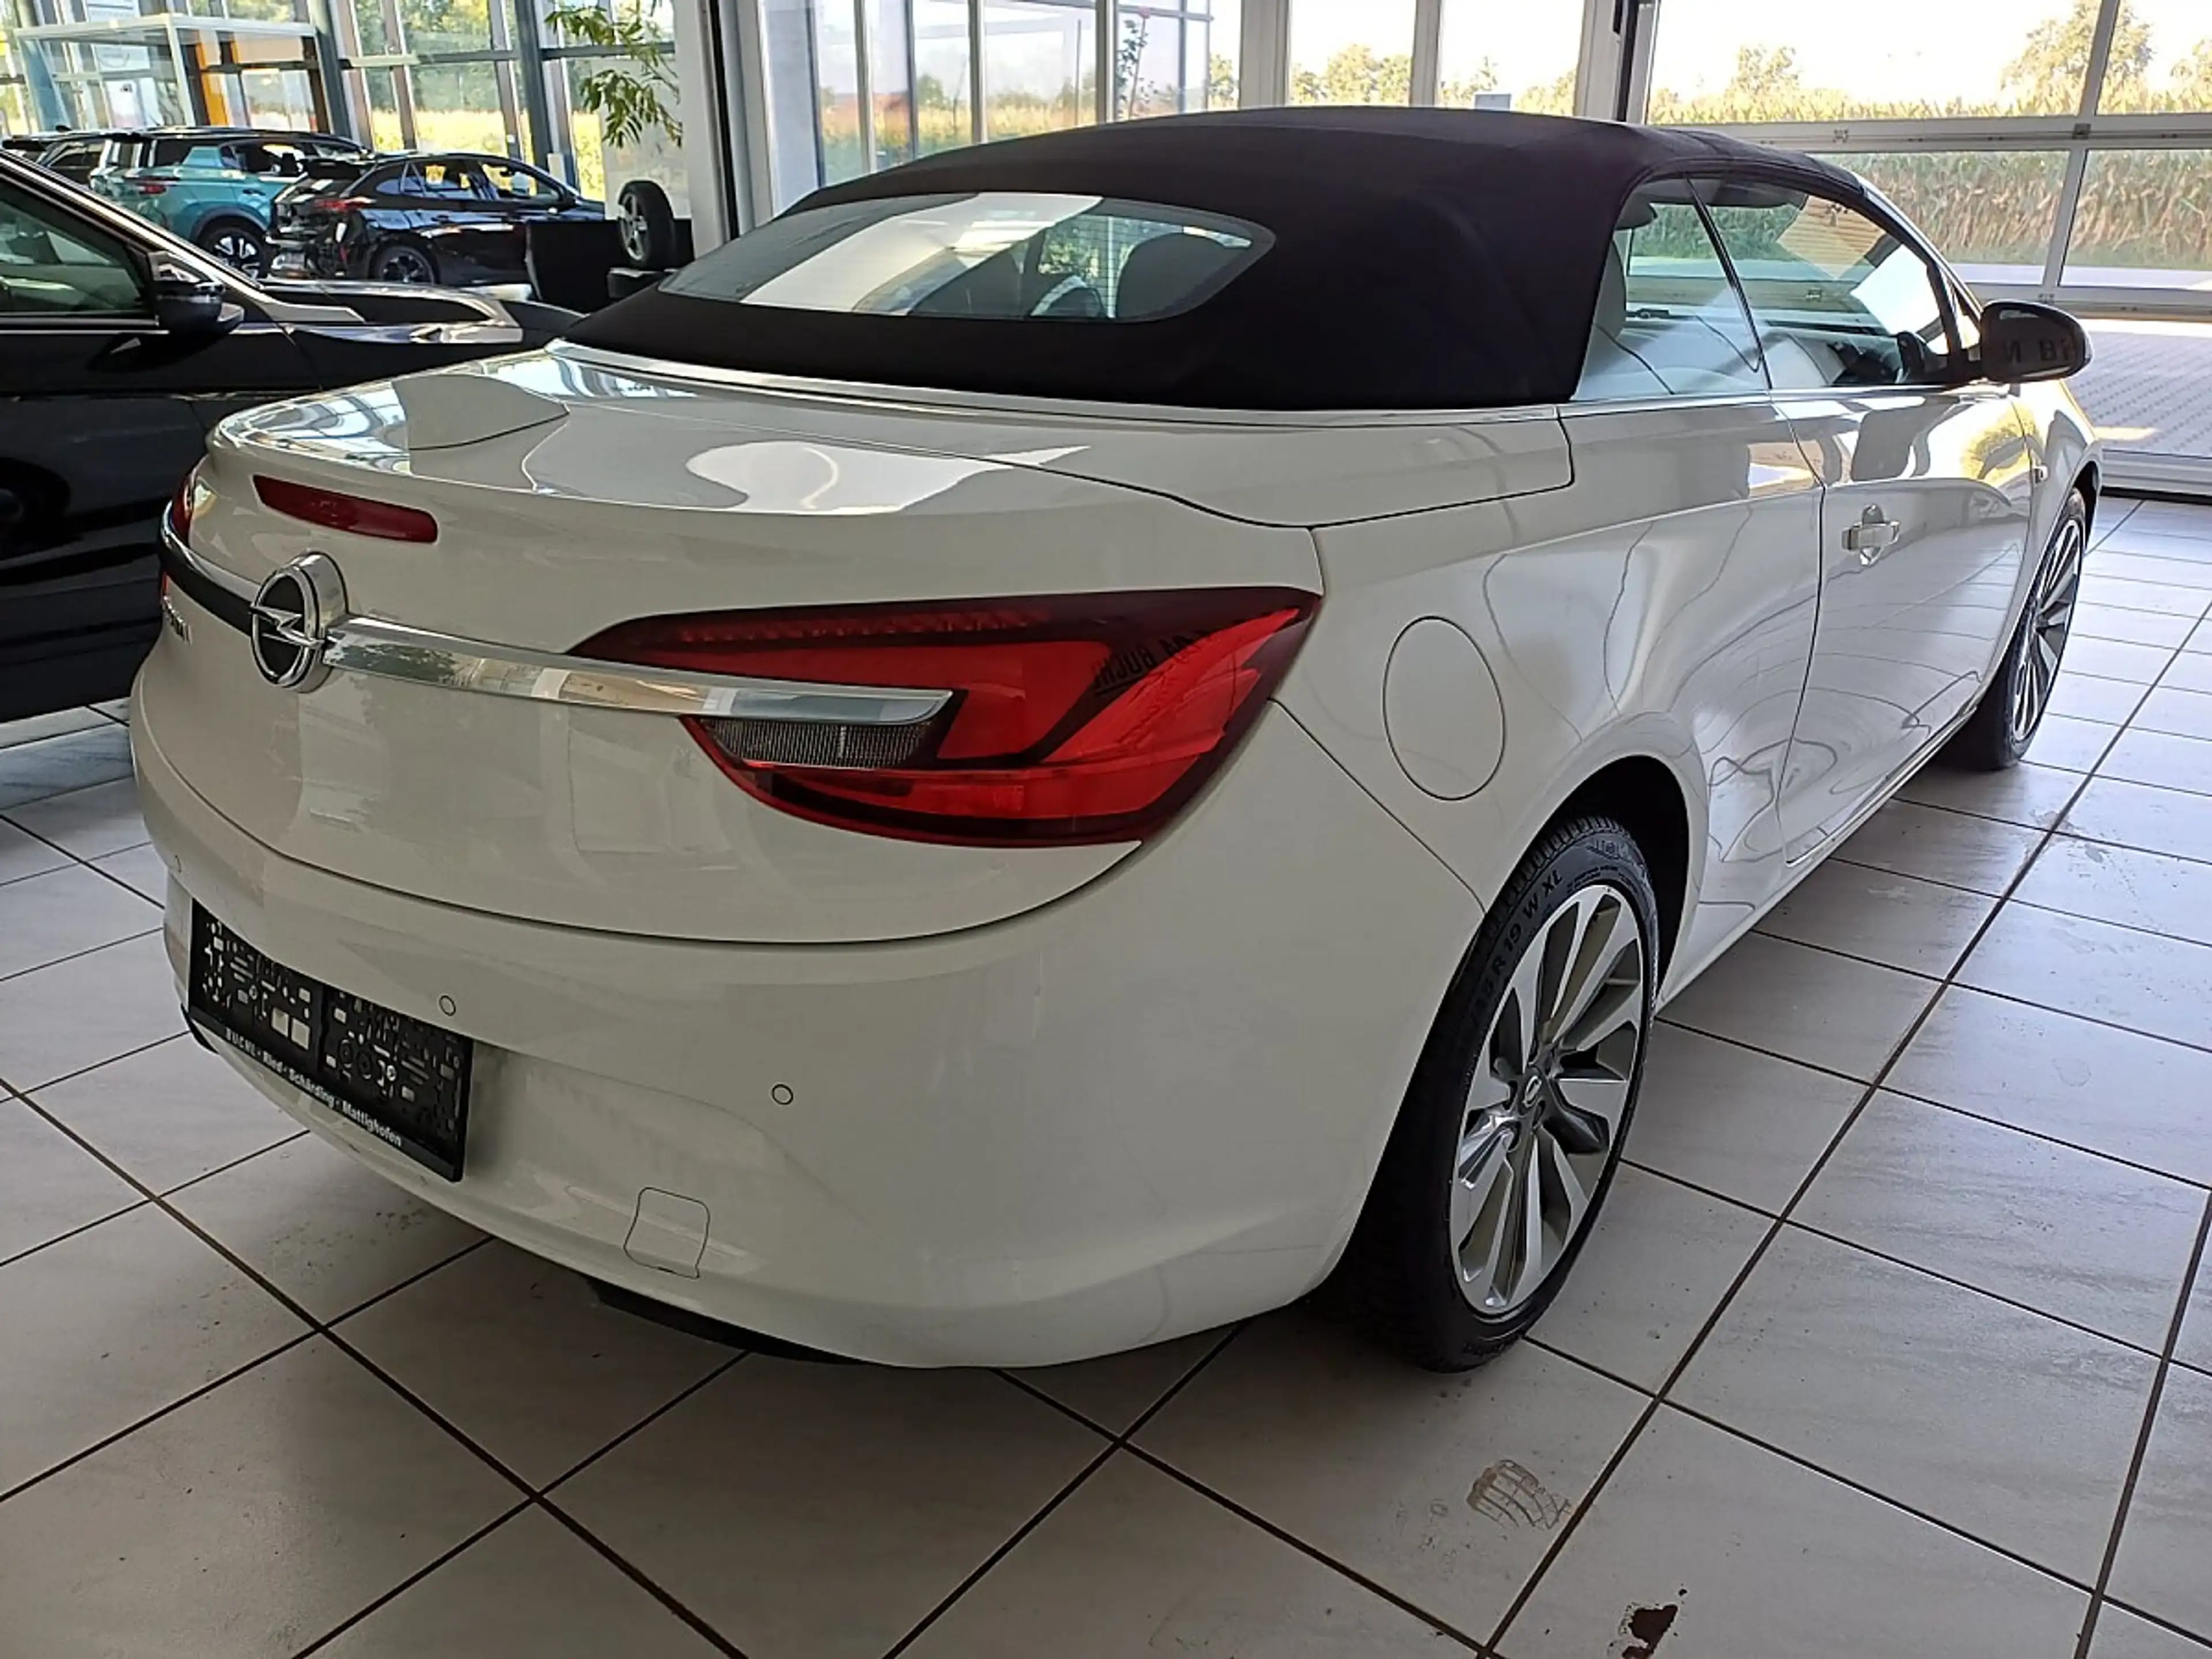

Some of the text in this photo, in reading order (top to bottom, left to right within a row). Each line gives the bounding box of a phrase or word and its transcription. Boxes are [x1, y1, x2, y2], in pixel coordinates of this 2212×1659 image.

[1505, 923, 1522, 952] 19
[1524, 893, 1539, 919] W
[1541, 869, 1563, 897] XL
[263, 1050, 283, 1074] Ried
[342, 1100, 402, 1147] Mattighofen
